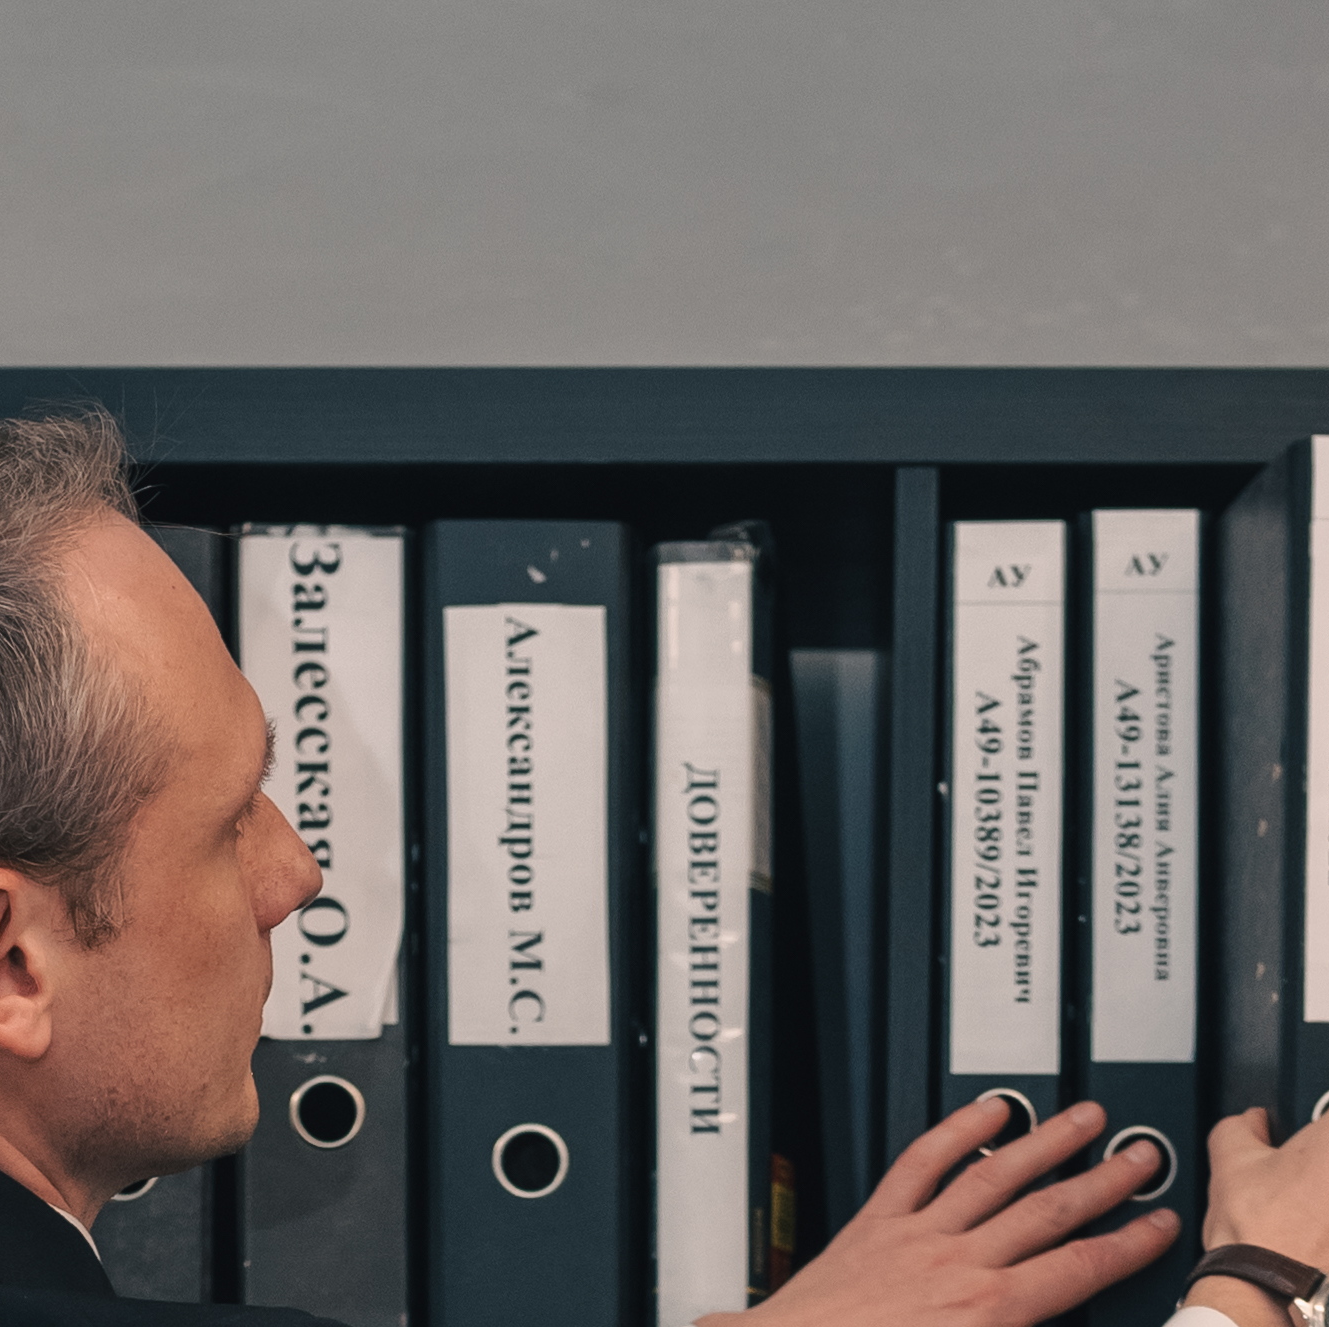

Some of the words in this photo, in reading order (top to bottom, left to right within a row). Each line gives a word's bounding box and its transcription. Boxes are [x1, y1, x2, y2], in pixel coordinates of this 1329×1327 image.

[986, 563, 1033, 590] АУ
[1124, 552, 1170, 579] АУ
[496, 617, 542, 913] Александров
[1010, 638, 1041, 761] Абрамов
[973, 692, 1004, 949] А49-10389/2023
[1016, 771, 1040, 857] Павел
[1114, 680, 1143, 936] А49-13138/2023
[296, 898, 350, 1036] О.А.
[508, 931, 545, 1035] М.С.
[684, 763, 722, 1135] ДОВЕРЕННОСТИ
[1007, 867, 1040, 1004] Игоревич
